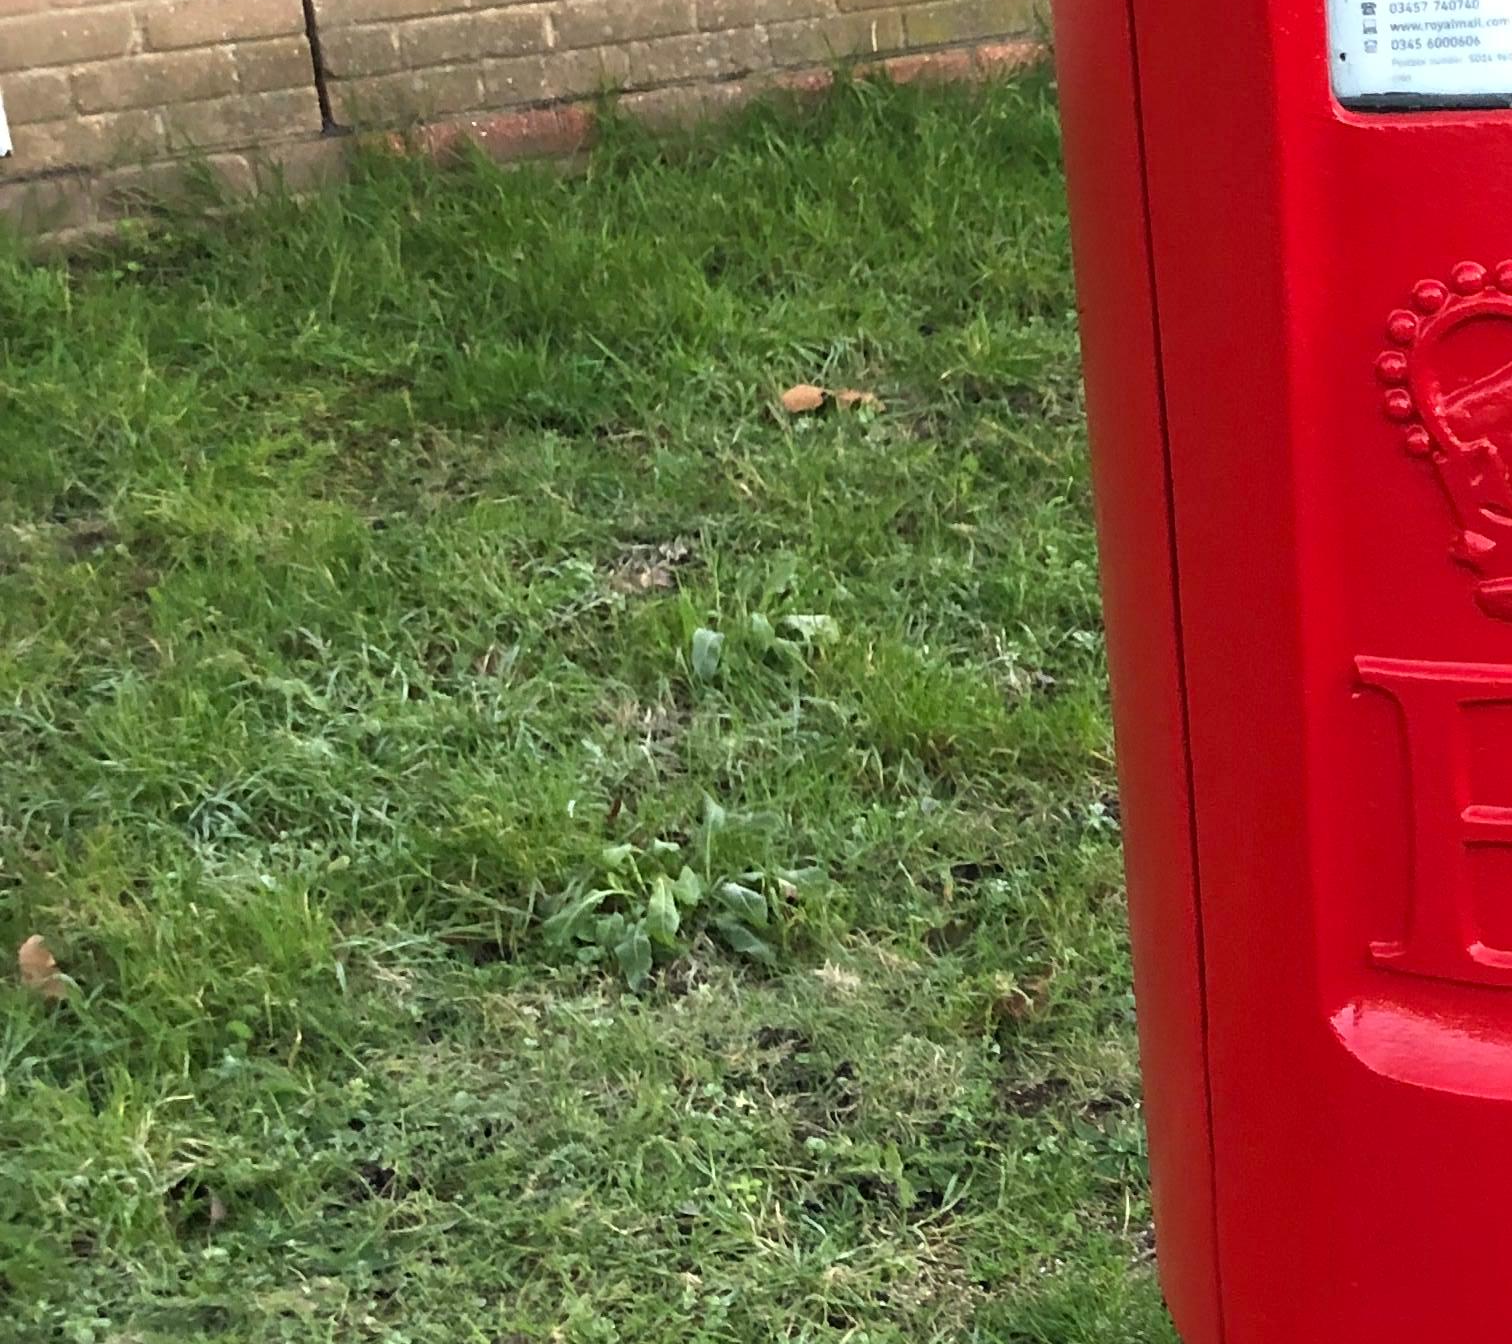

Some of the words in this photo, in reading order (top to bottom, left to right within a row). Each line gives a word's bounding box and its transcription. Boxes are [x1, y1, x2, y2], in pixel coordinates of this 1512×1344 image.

[1389, 1, 1428, 14] 03457
[1390, 17, 1510, 33] www.royalmail.com
[1391, 38, 1422, 51] 0345
[1427, 35, 1481, 49] 6000606
